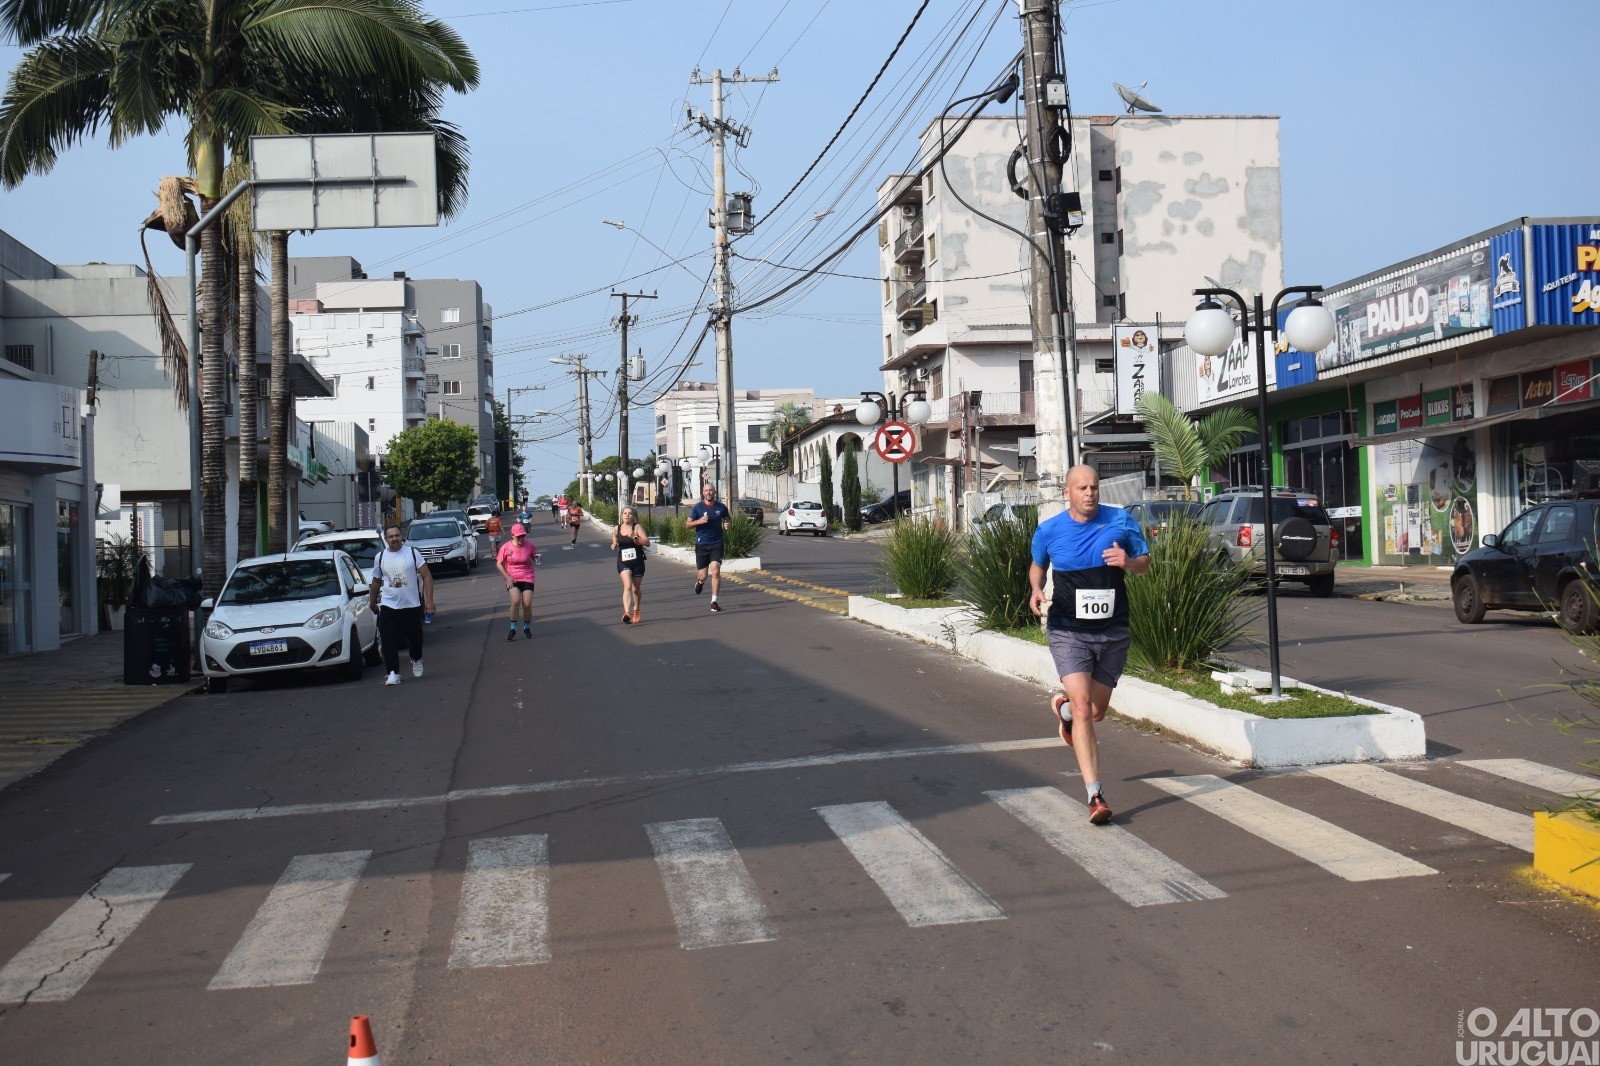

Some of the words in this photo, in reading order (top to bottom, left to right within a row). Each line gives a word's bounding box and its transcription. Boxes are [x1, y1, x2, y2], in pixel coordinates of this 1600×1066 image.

[1376, 275, 1418, 298] AGROPECUÁRIA
[1366, 287, 1429, 338] PAULO
[1228, 373, 1251, 390] Lanches
[1525, 380, 1552, 400] Astro
[1428, 400, 1449, 416] BLOKUS
[1082, 602, 1109, 614] 100
